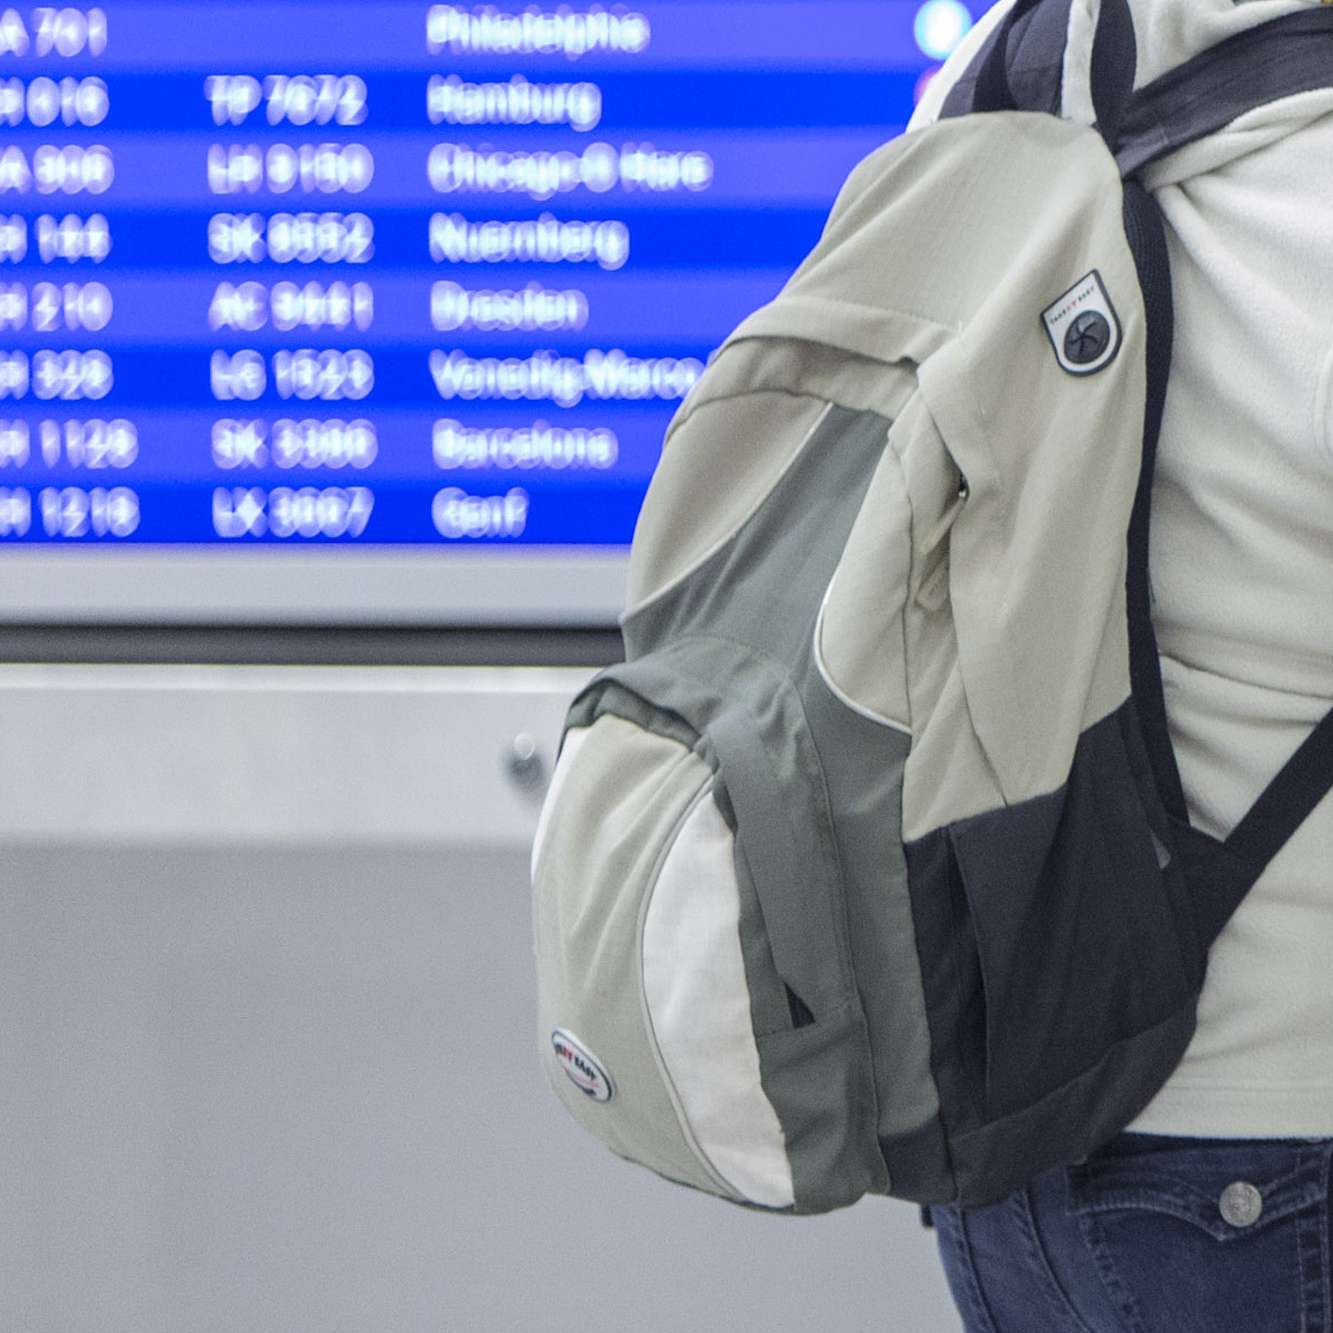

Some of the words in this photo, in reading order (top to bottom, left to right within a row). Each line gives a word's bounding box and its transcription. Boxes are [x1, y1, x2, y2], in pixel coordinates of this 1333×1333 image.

[428, 6, 649, 57] Philadelphia
[428, 76, 600, 131] Hamburg
[430, 214, 628, 269] Nuernberg
[432, 282, 587, 329] Dresden
[434, 420, 617, 467] Barcelona
[433, 488, 527, 536] Genf
